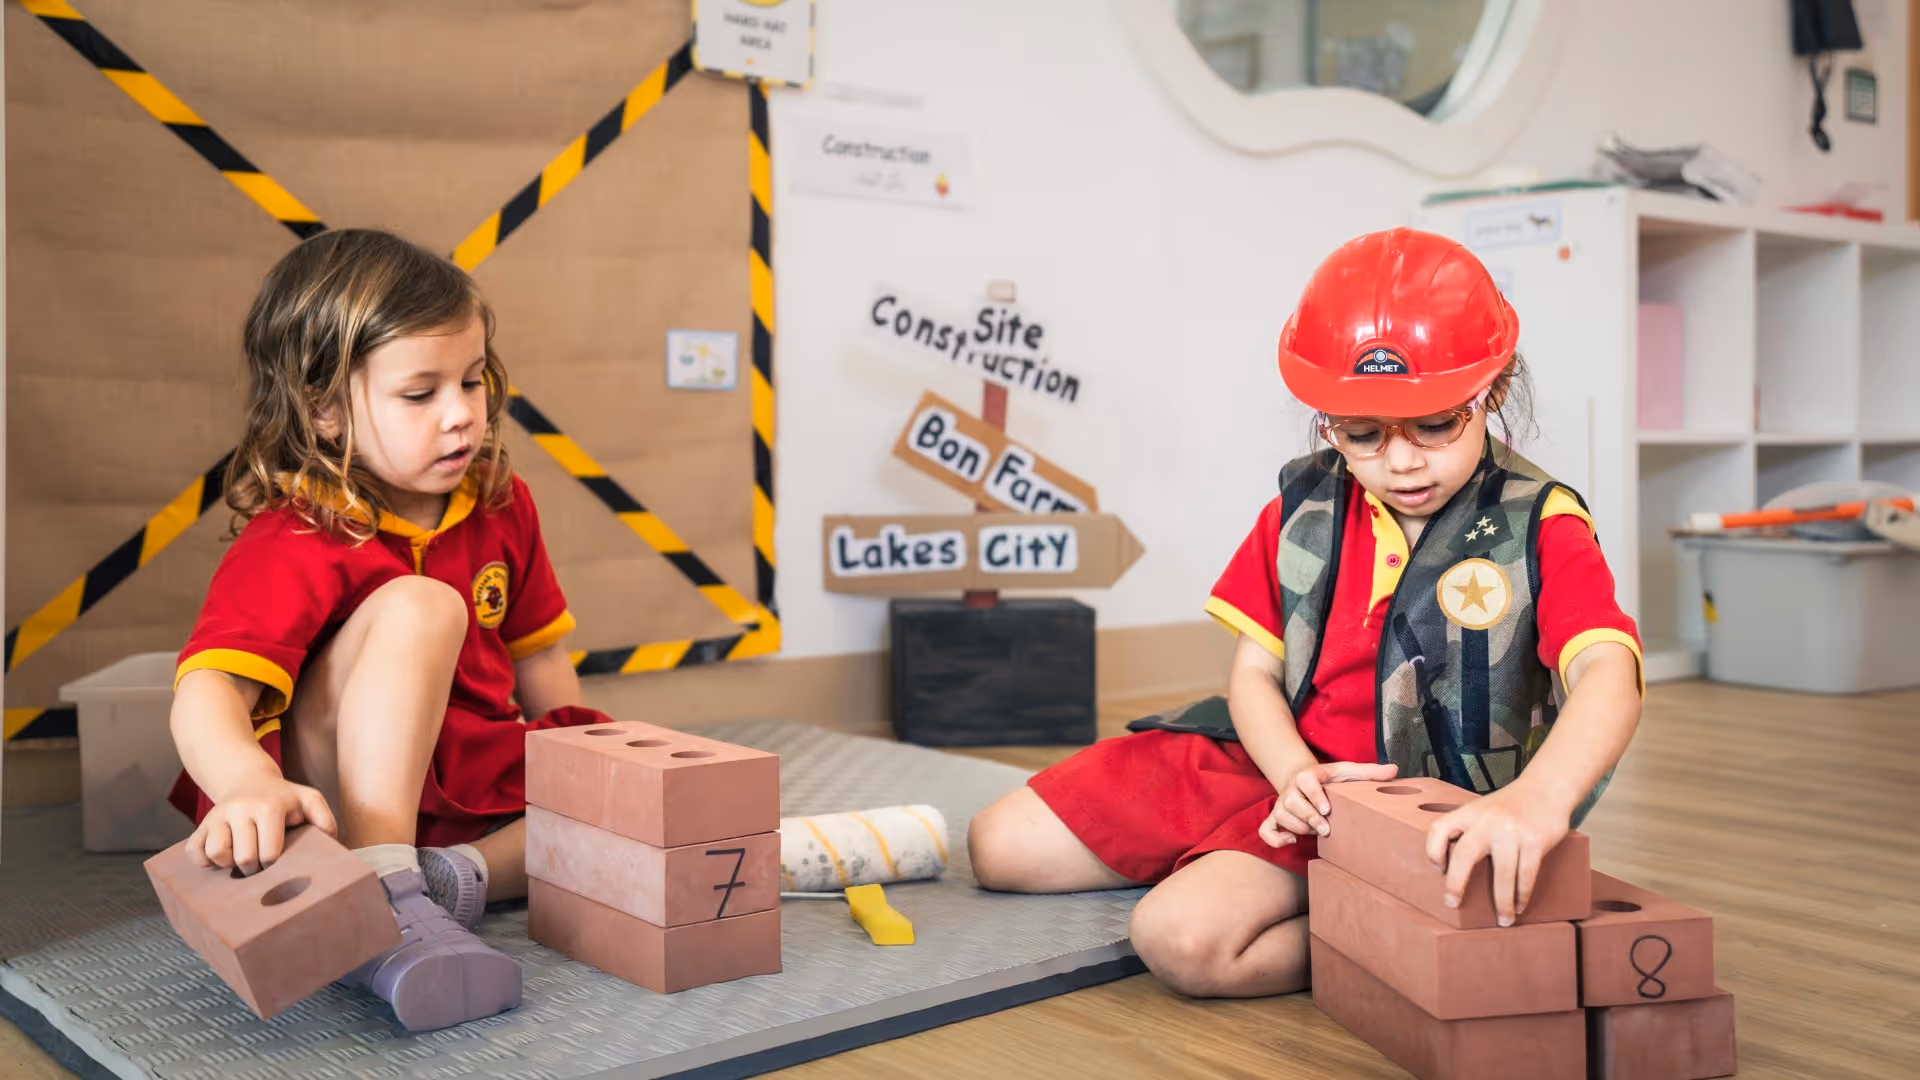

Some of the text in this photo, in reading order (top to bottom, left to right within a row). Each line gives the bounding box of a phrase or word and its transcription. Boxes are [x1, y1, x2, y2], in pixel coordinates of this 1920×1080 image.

[822, 134, 930, 163] Construction
[974, 307, 1043, 350] Site
[1363, 364, 1399, 373] HELMET
[916, 412, 981, 476] Bon
[838, 533, 957, 569] Lakes
[705, 848, 746, 919] 7
[1629, 935, 1673, 999] 8
